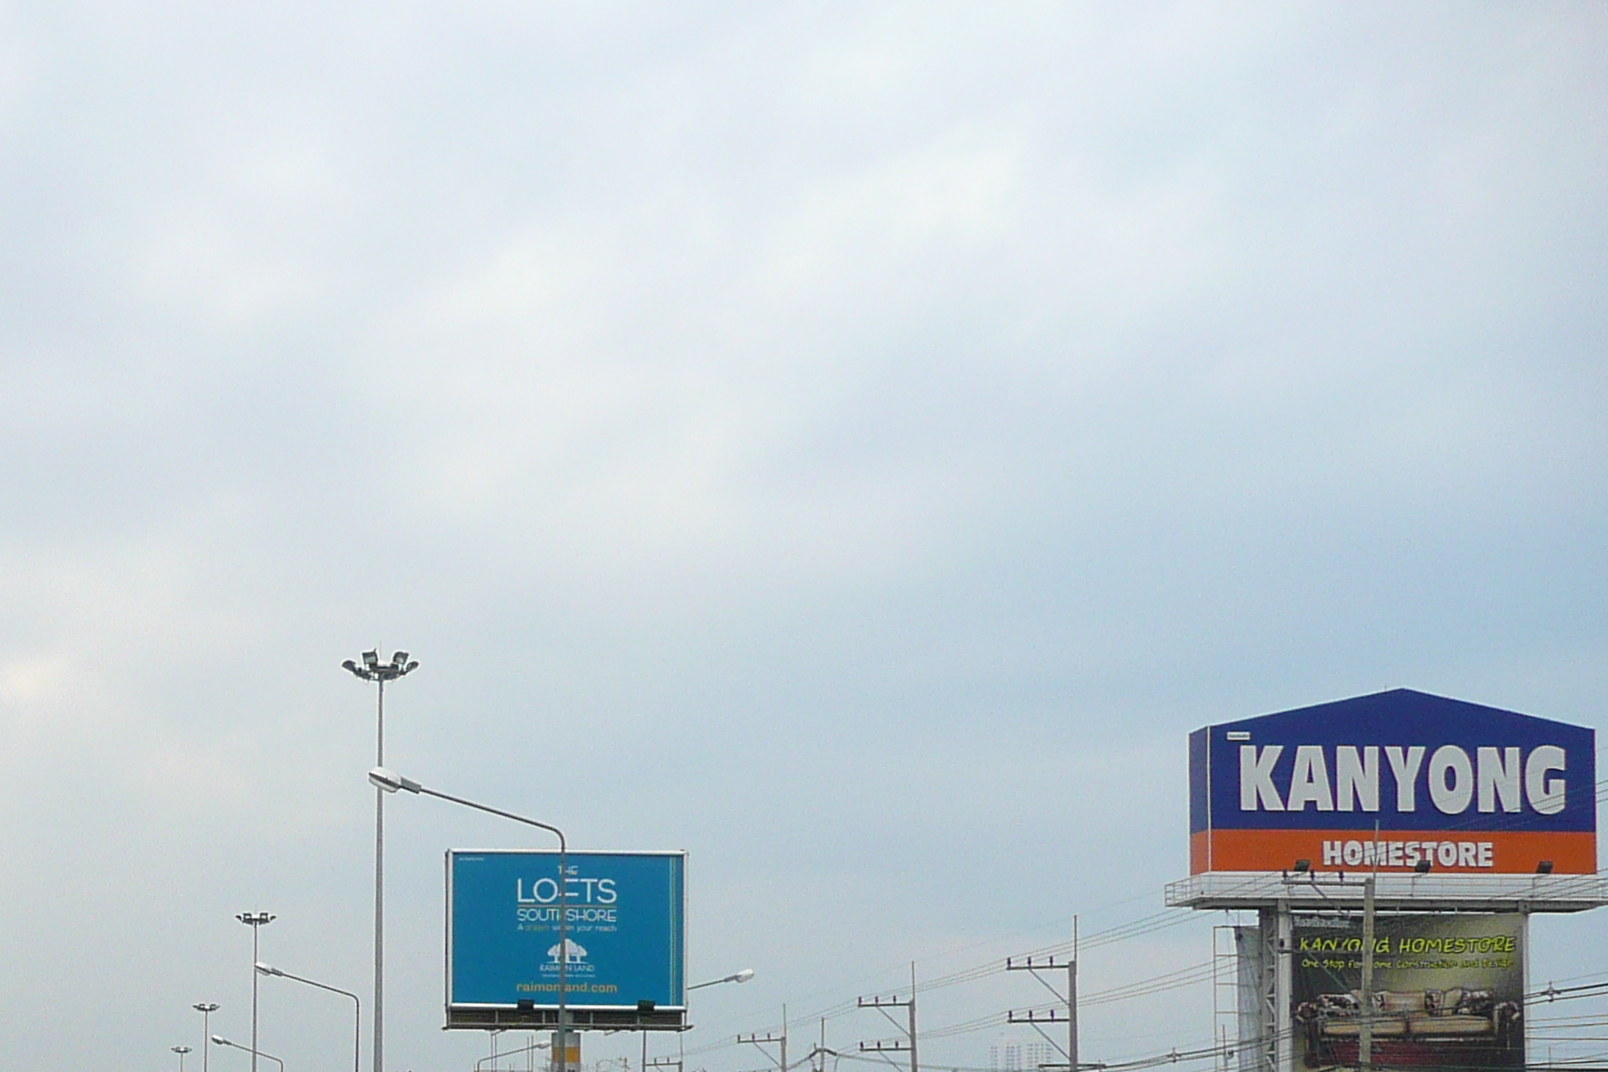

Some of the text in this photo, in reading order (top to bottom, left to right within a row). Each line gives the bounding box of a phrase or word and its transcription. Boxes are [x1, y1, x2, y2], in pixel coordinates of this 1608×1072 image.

[1238, 744, 1567, 815] KANYONG
[1322, 840, 1494, 868] HOMESTORE
[517, 877, 617, 903] LOFTS
[1399, 935, 1516, 953] HOMESTORE
[540, 964, 572, 972] RAIMN
[1301, 959, 1319, 968] One
[1323, 959, 1345, 971] Stop
[517, 982, 618, 993] raimonand.com
